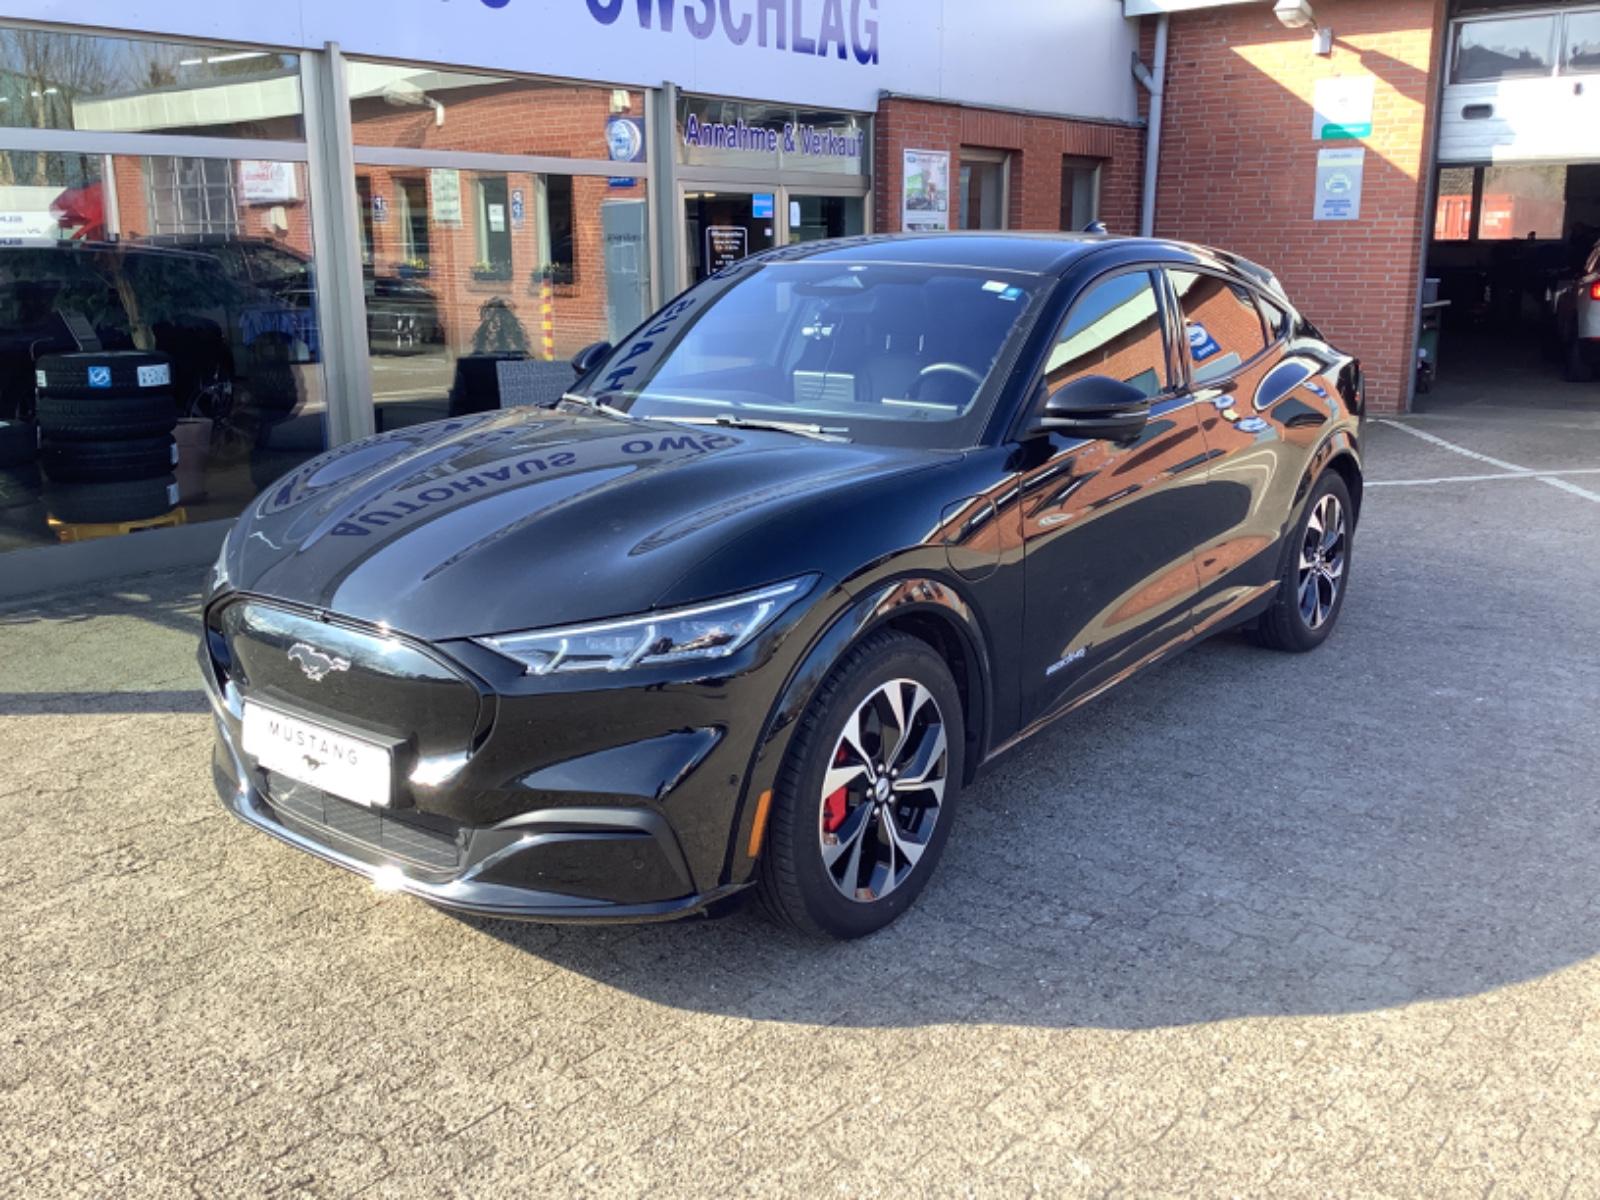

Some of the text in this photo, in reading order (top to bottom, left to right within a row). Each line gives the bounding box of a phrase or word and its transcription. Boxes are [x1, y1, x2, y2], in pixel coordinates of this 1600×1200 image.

[586, 0, 879, 64] CHLAG
[686, 113, 863, 157] Annahme & Verkauf
[269, 720, 357, 766] MUSTANG
